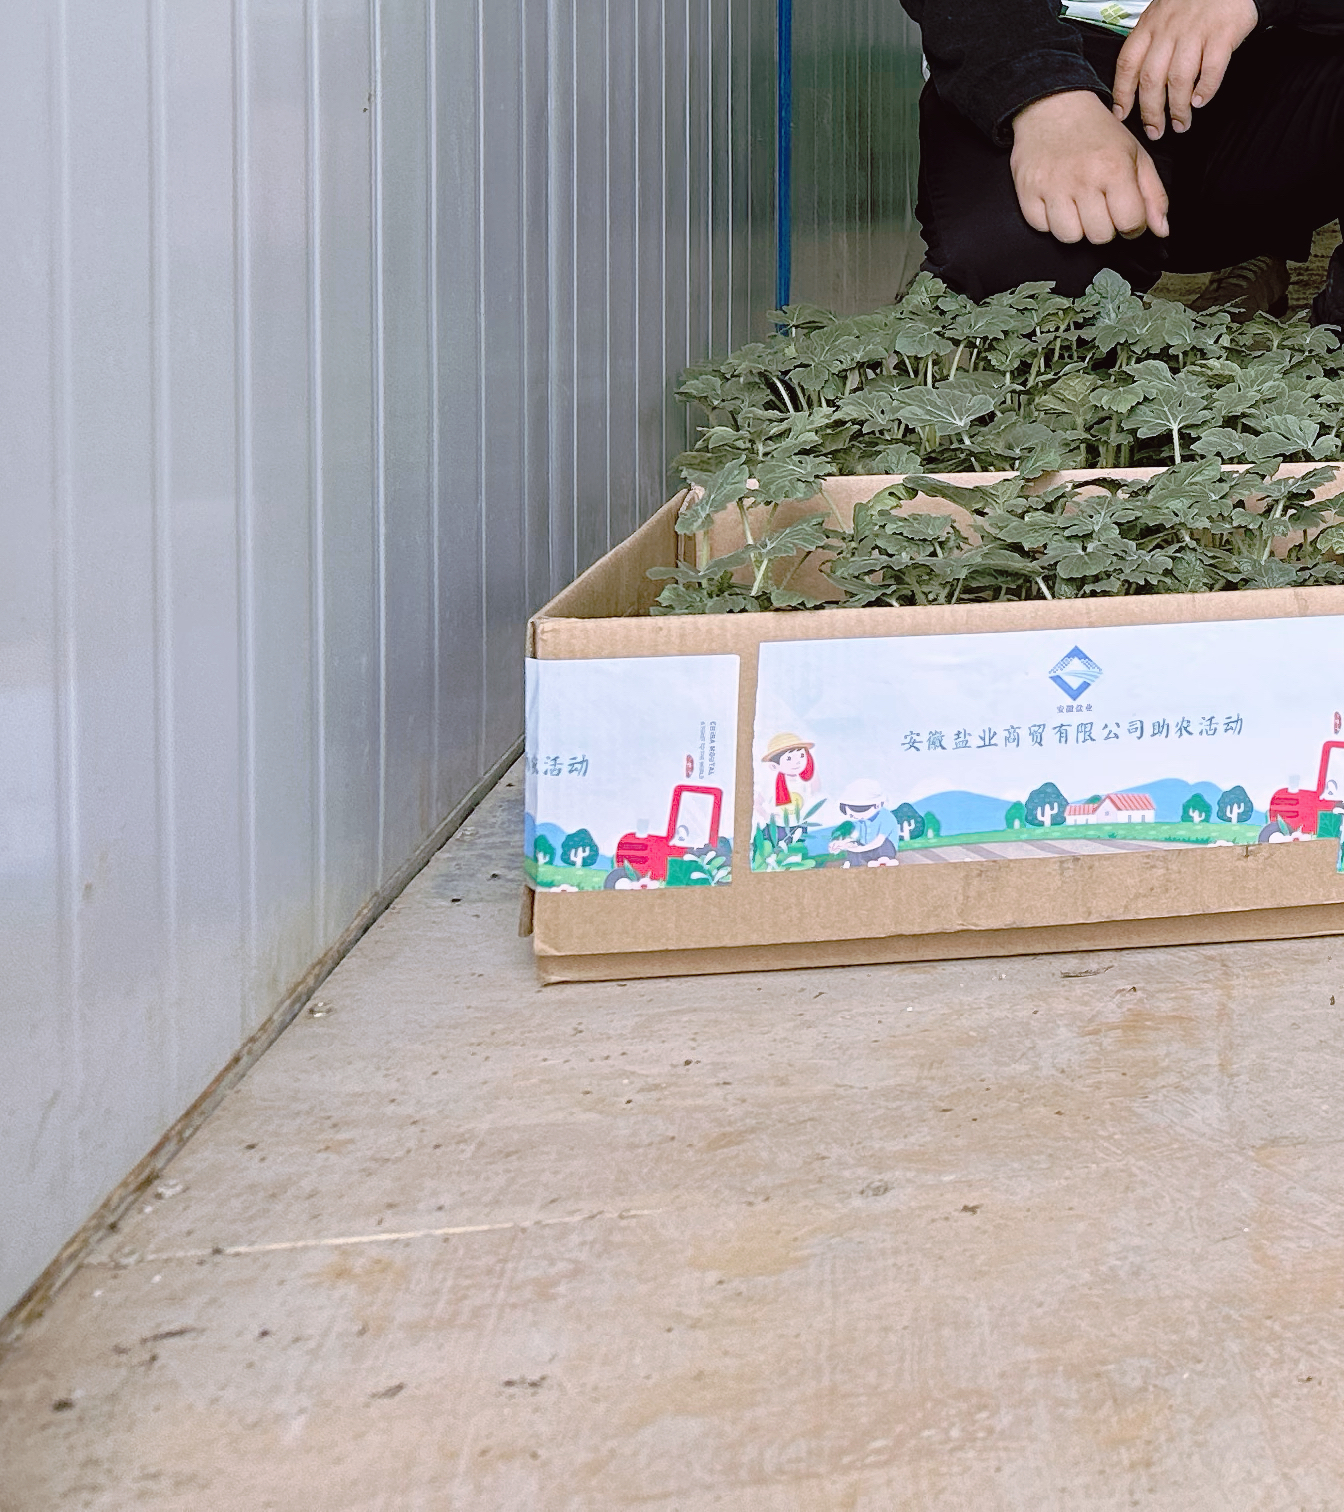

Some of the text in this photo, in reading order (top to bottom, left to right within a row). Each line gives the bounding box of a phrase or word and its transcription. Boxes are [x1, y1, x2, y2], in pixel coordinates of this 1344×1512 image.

[900, 712, 1243, 752] 安徽盐业商贸有限公司助农活动
